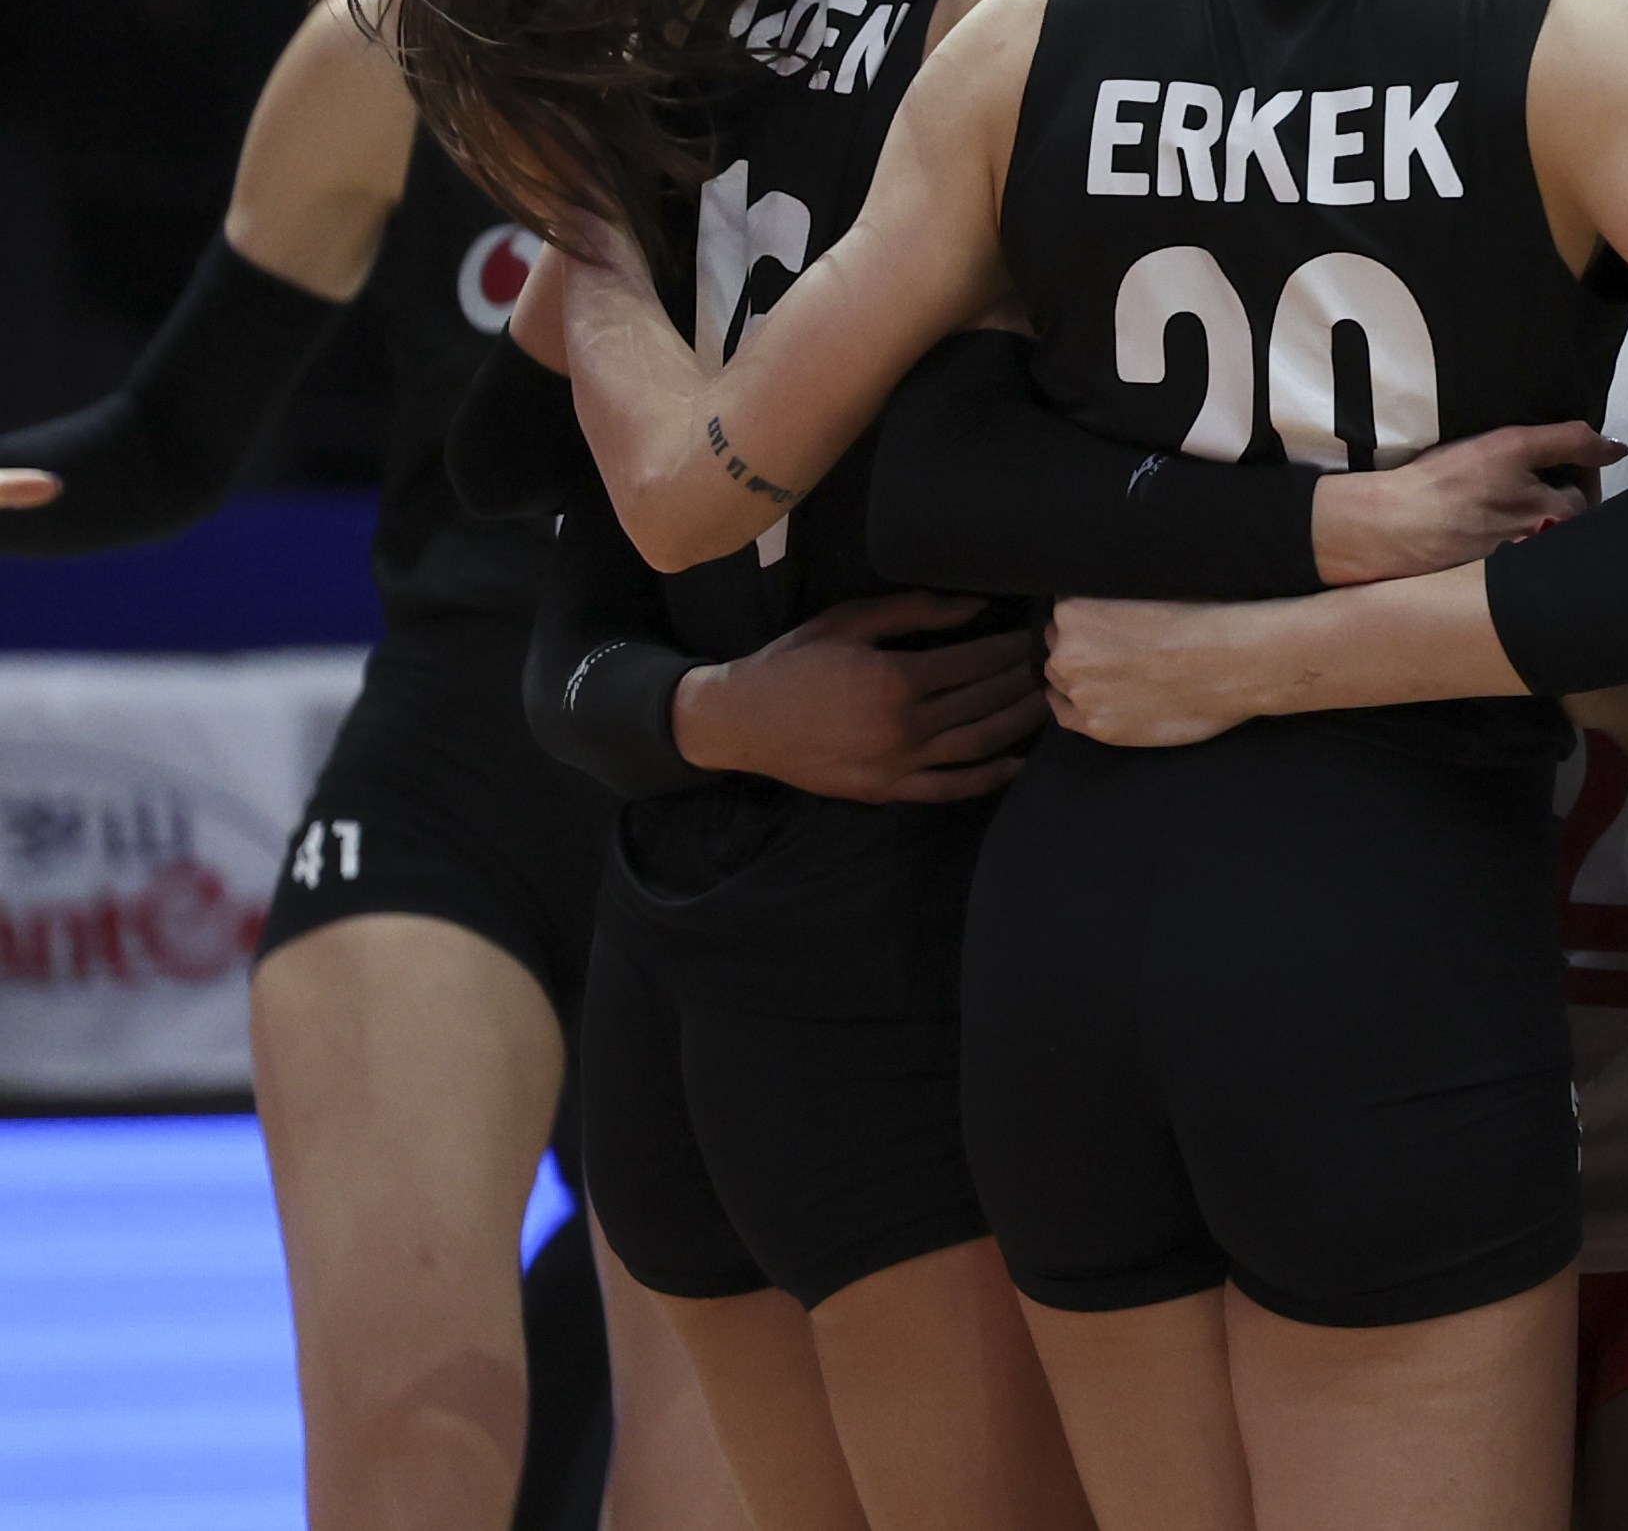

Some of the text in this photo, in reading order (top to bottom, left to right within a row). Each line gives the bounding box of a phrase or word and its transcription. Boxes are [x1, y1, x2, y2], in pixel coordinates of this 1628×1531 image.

[1086, 78, 1465, 206] ERKEK
[1114, 244, 1441, 472] 20
[291, 818, 362, 890] 41
